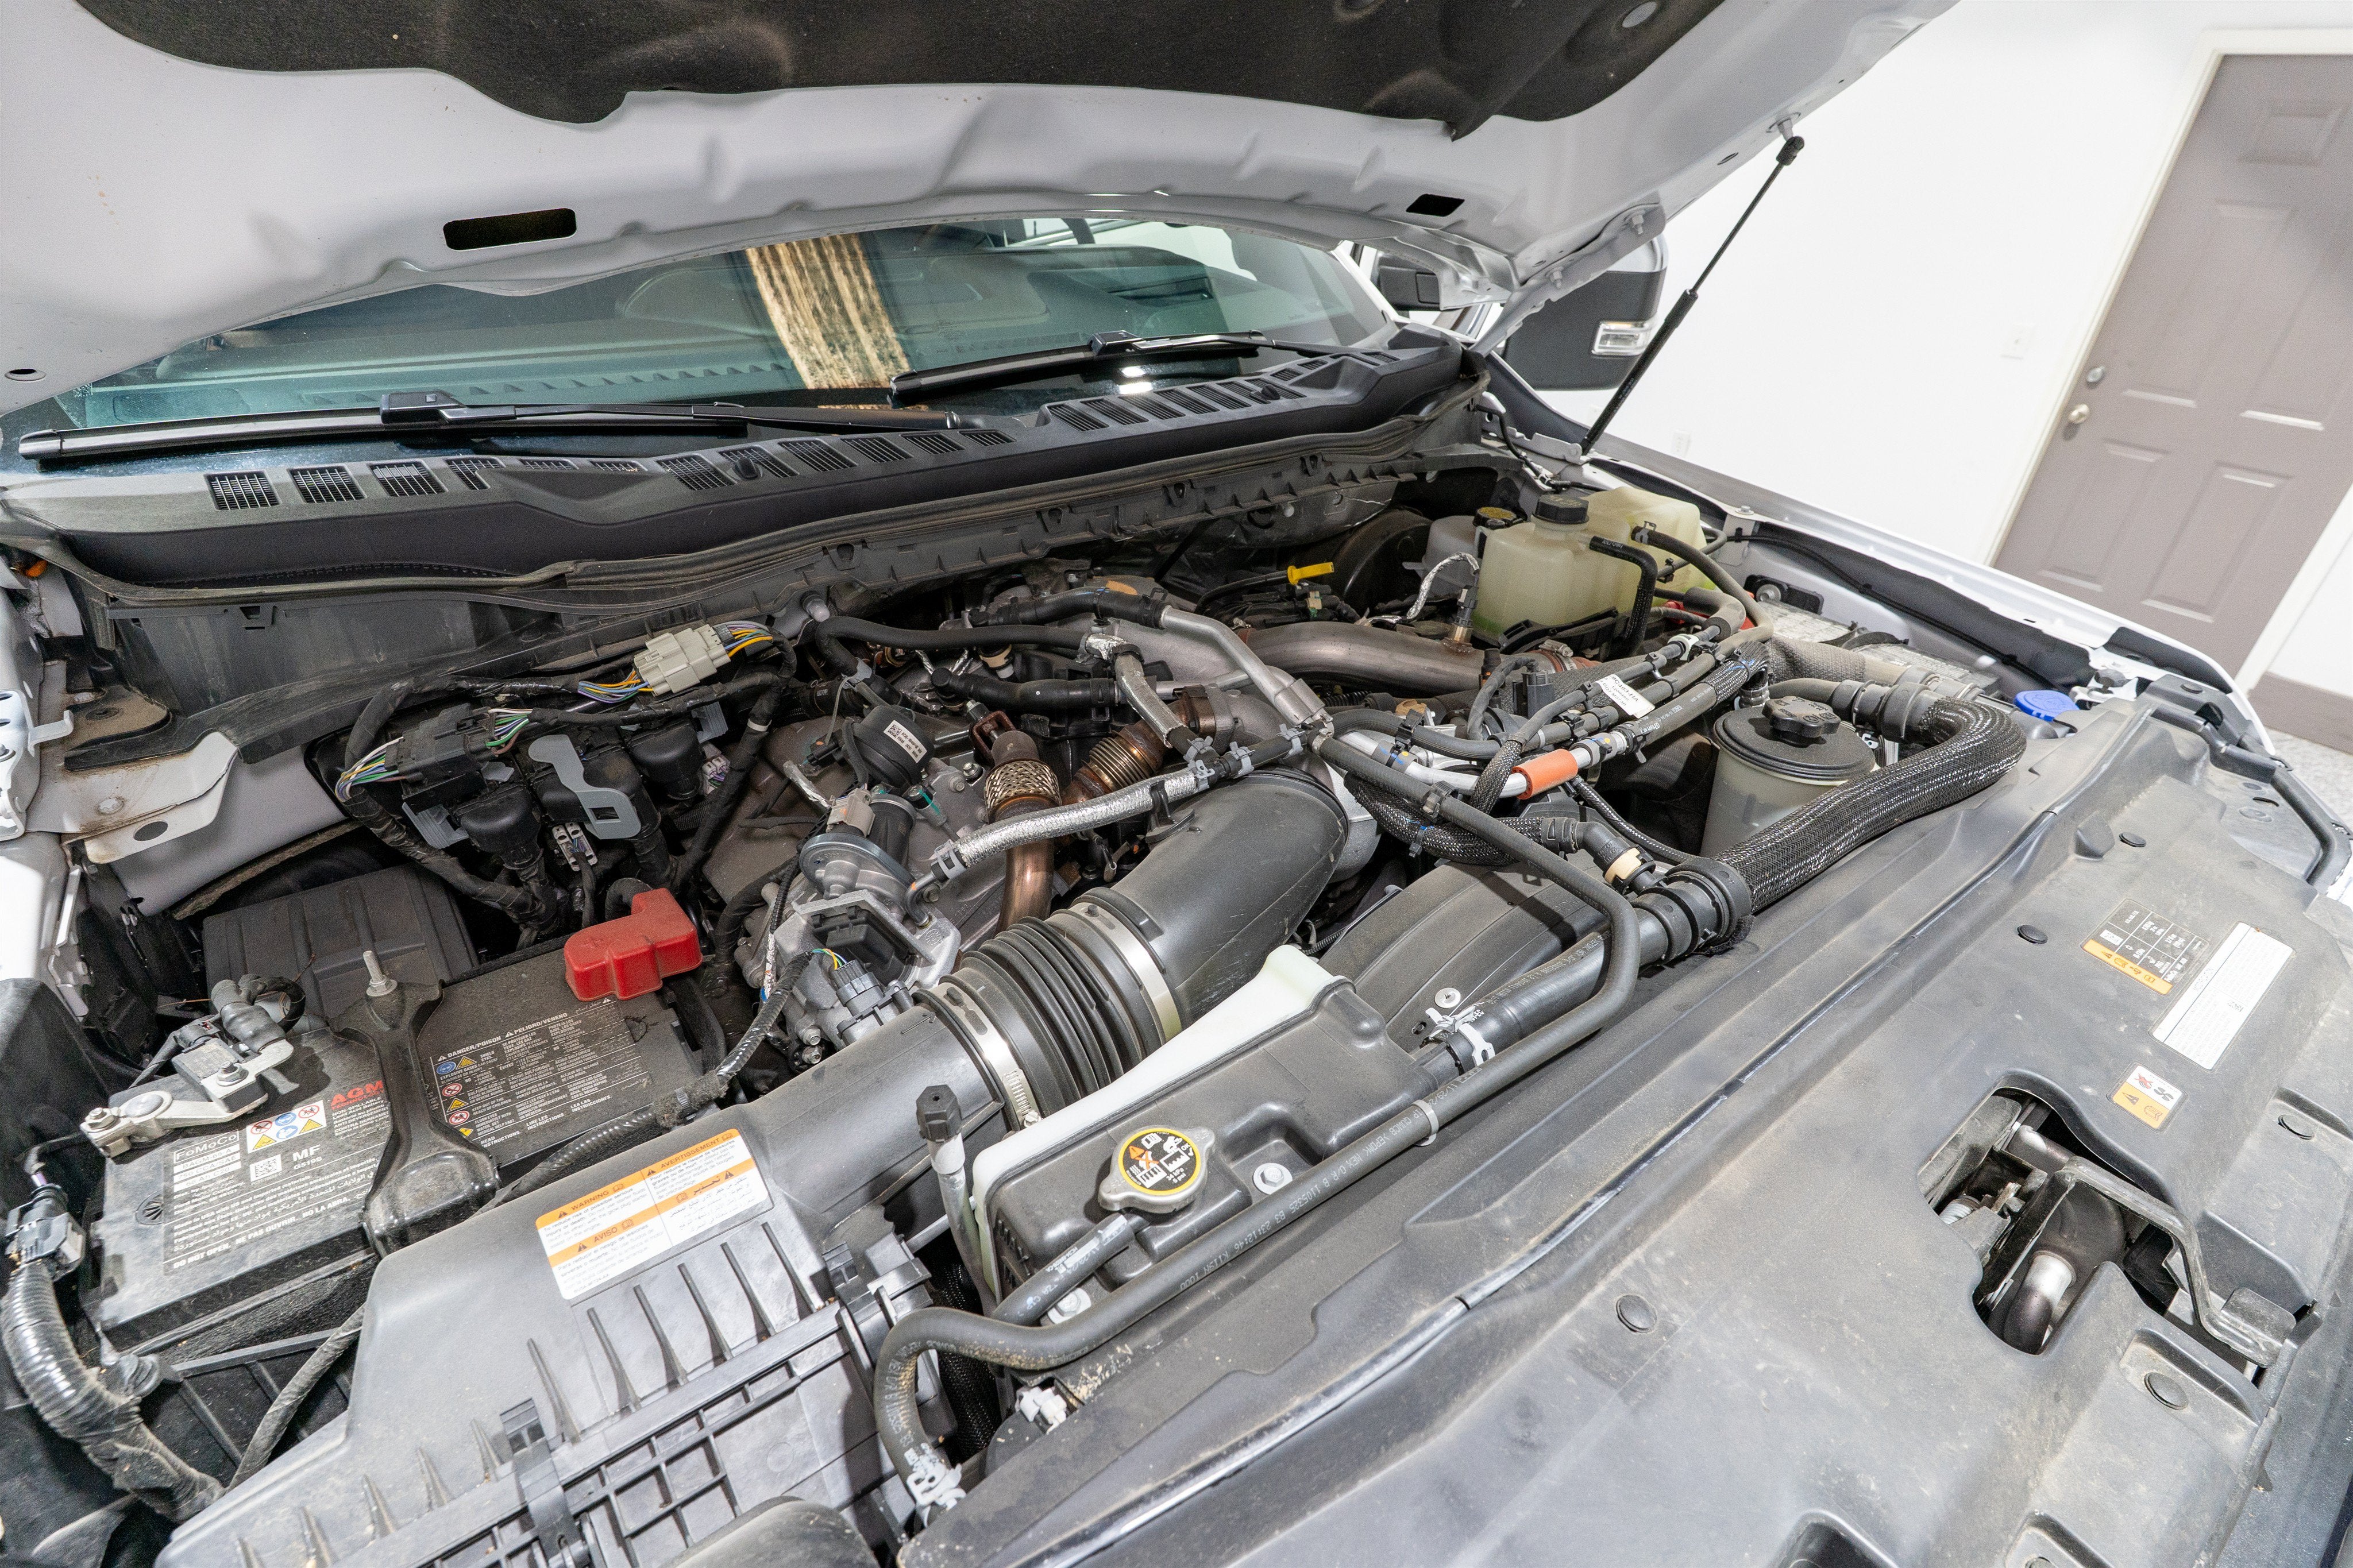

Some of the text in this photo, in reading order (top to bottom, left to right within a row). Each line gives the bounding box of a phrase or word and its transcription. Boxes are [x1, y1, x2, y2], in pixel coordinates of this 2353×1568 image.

[514, 1011, 568, 1034] PELIGRO/VENENO
[447, 1034, 502, 1058] DANGER/POISON
[330, 1077, 383, 1107] AGM
[331, 1095, 381, 1117] NON-SPILLABLE
[332, 1098, 384, 1121] Lead Acid Battery
[472, 1108, 487, 1116] REACH
[491, 1098, 512, 1109] CHILDREN.
[570, 1094, 613, 1113] INSTRUCCIONES.
[334, 1121, 358, 1134] CONTRA
[474, 1117, 488, 1125] FLUSH
[475, 1115, 502, 1128] IMMEDIATELY
[476, 1123, 491, 1132] WATER.
[477, 1126, 495, 1136] MEDICAL
[526, 1112, 566, 1130] INSTRUCTIONS.
[526, 1118, 539, 1126] LIRE
[176, 1131, 237, 1161] FoMoCo
[480, 1136, 496, 1145] READ
[292, 1143, 321, 1163] MF
[293, 1155, 322, 1171] G519S
[659, 1137, 721, 1169] AVERTISSEMENT
[1344, 1152, 1363, 1169] MEX
[178, 1154, 236, 1180] 750 CCA/SAE
[173, 1218, 192, 1230] Made
[200, 1210, 215, 1221] USA
[215, 1204, 229, 1214] with
[230, 1200, 240, 1209] US
[241, 1196, 252, 1205] and
[253, 1185, 281, 1200] imported
[281, 1172, 313, 1189] materials.
[551, 1216, 571, 1229] reduce
[589, 1196, 613, 1211] possible
[612, 1187, 634, 1199] serious
[570, 1189, 610, 1211] WARNING
[1286, 1183, 1323, 1213] 1105325
[1271, 1208, 1287, 1224] B3
[173, 1194, 350, 1270] DO NOT OPEN. NE PAS OUVRIR. NO LA ABRA.
[592, 1226, 619, 1242] AVISO
[1230, 1219, 1274, 1253] 23:12:46
